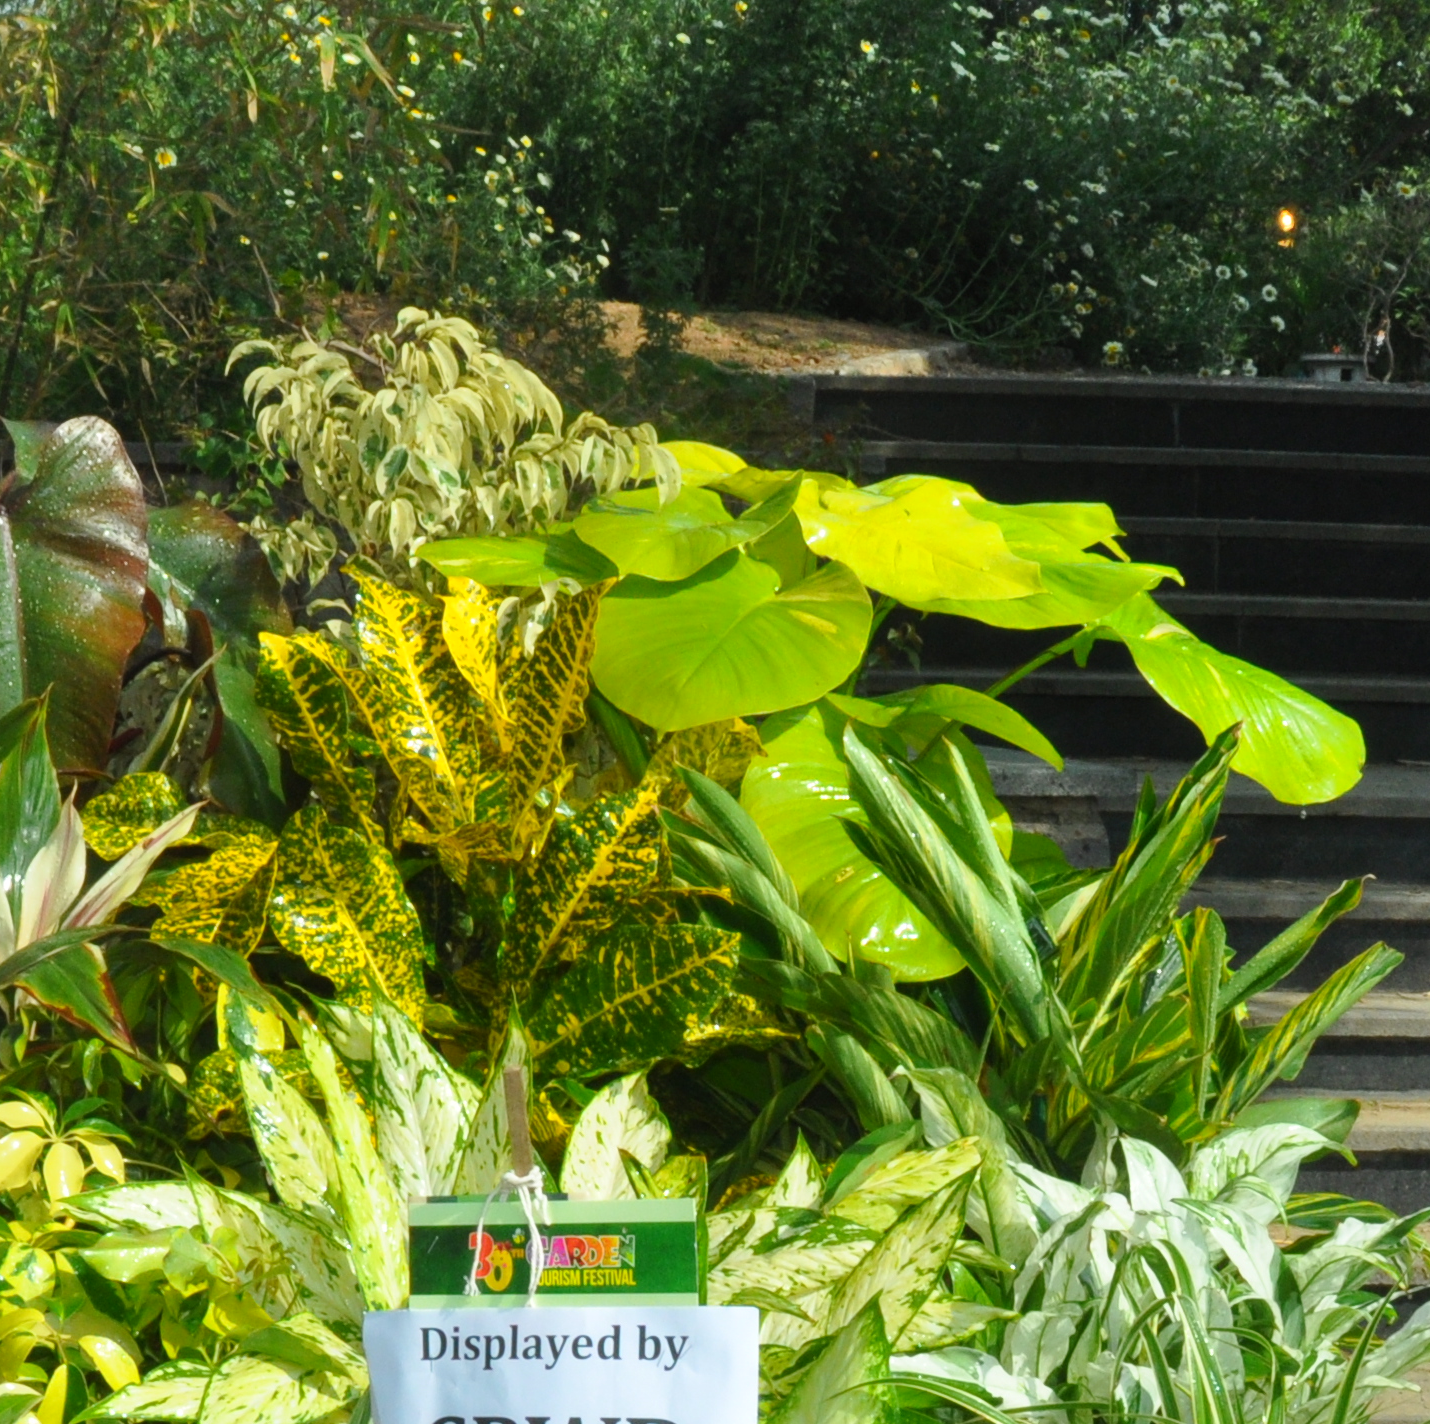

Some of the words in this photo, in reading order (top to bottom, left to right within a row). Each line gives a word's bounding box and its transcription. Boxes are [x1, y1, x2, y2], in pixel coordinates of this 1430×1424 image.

[536, 1269, 581, 1286] OURISM
[583, 1269, 636, 1286] FESTIVAL
[419, 1324, 622, 1370] Displayed
[637, 1324, 689, 1370] by
